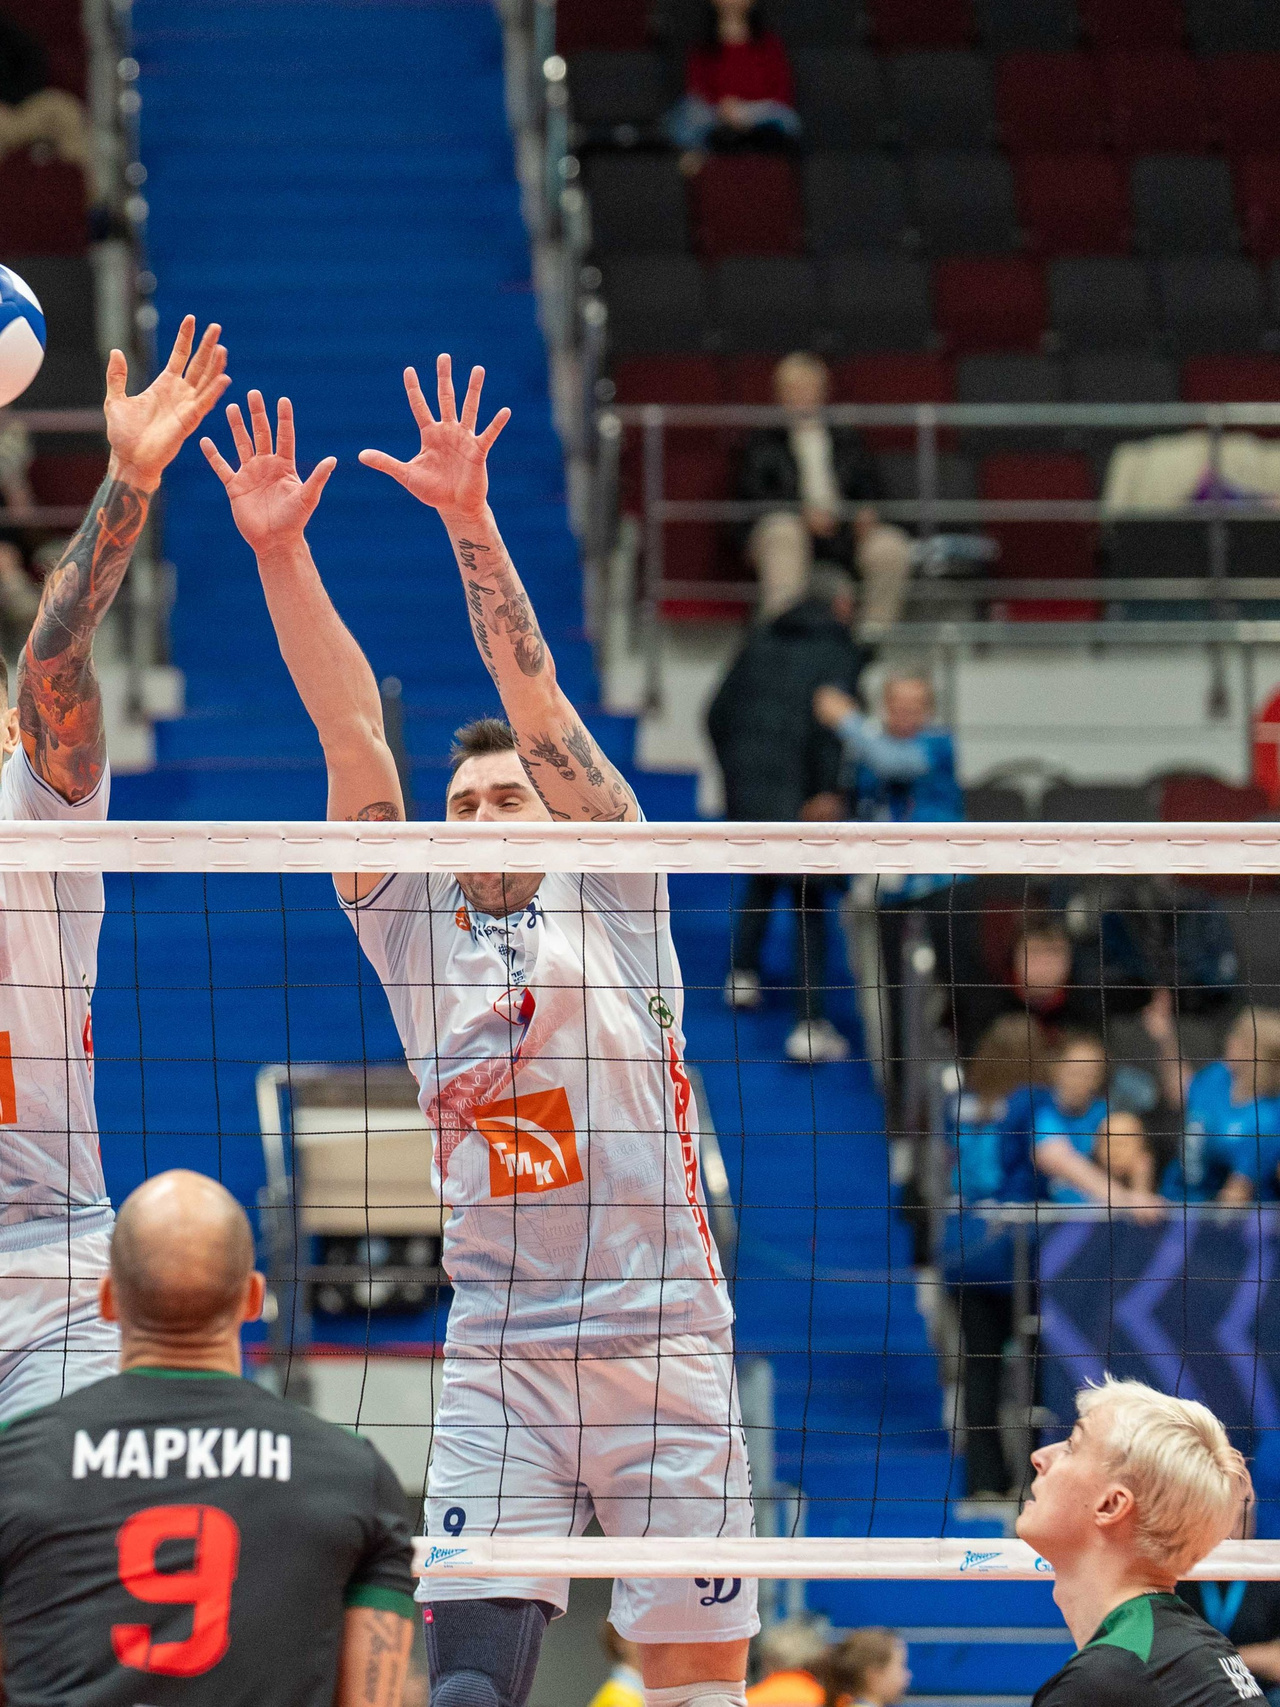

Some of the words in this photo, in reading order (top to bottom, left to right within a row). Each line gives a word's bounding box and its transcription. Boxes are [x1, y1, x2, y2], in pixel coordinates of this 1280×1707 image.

[71, 1428, 292, 1482] МАРКИН
[443, 1507, 467, 1537] 9
[111, 1503, 241, 1678] 9
